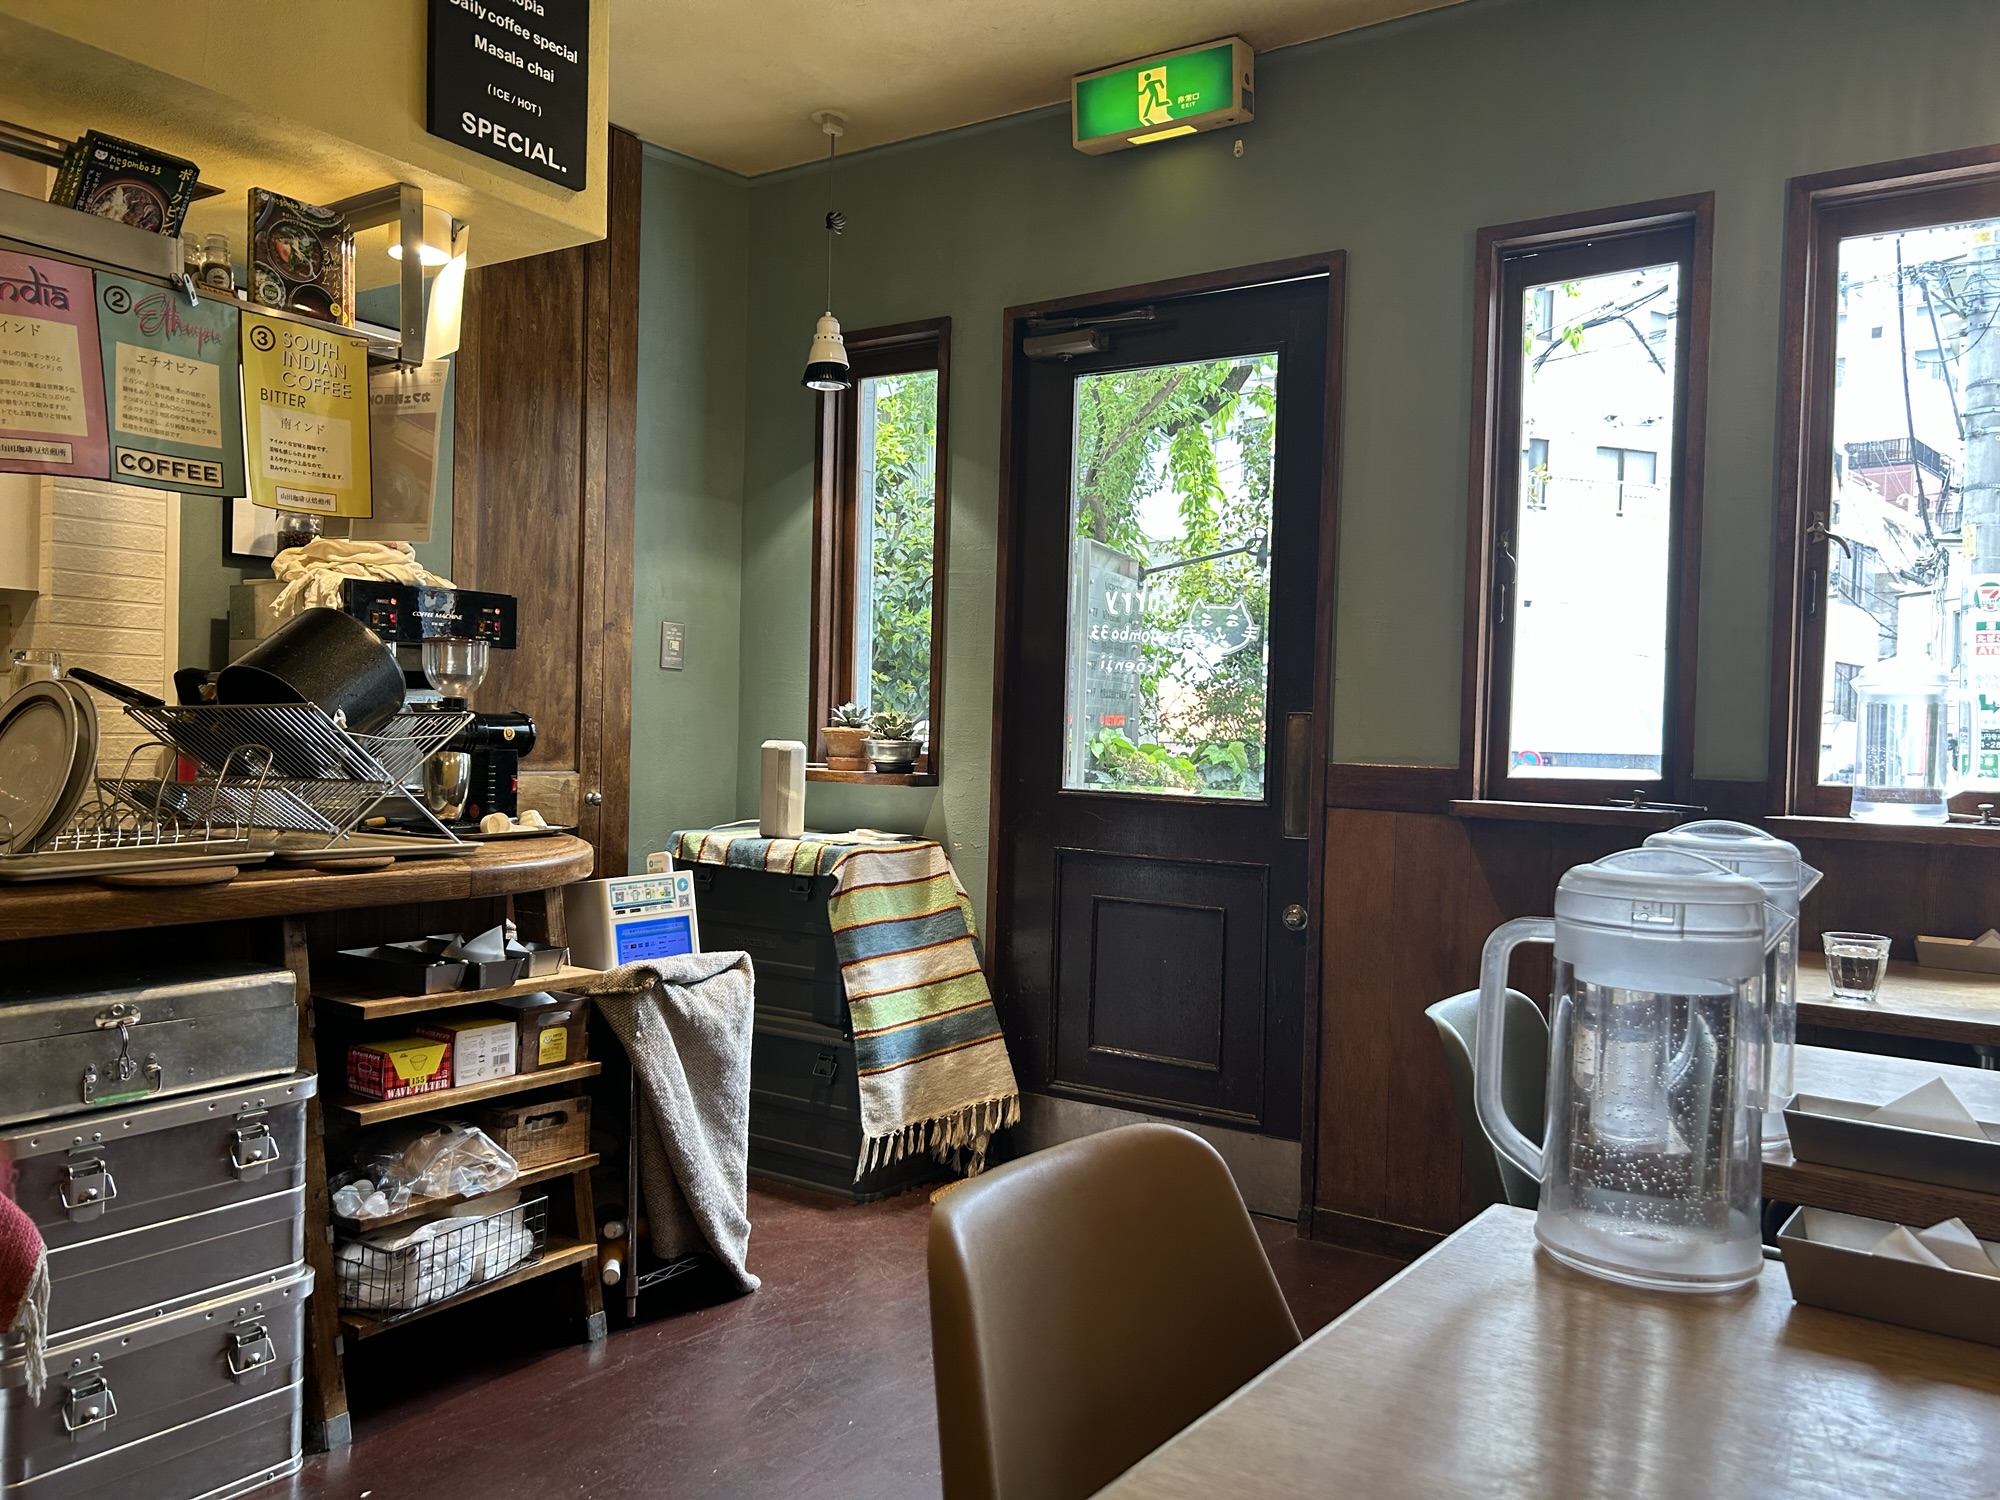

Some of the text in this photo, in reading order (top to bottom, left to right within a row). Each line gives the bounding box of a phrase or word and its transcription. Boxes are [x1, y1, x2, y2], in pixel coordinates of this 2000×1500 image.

[512, 0, 545, 17] opia
[487, 11, 531, 40] coffee
[533, 33, 578, 64] special
[474, 33, 555, 83] Masala chai
[1178, 92, 1200, 104] 非常口
[1181, 101, 1196, 109] EXIT
[461, 111, 567, 174] SPECIAL.
[281, 331, 340, 361] SOUTH
[137, 354, 198, 376] エチオピア
[282, 350, 347, 380] INDIAN
[281, 370, 352, 400] COFFEE
[260, 387, 307, 408] BITTER
[280, 418, 325, 435] 南インド
[120, 453, 219, 484] COFFEE
[411, 1076, 425, 1085] 155
[414, 1079, 448, 1094] FILTER
